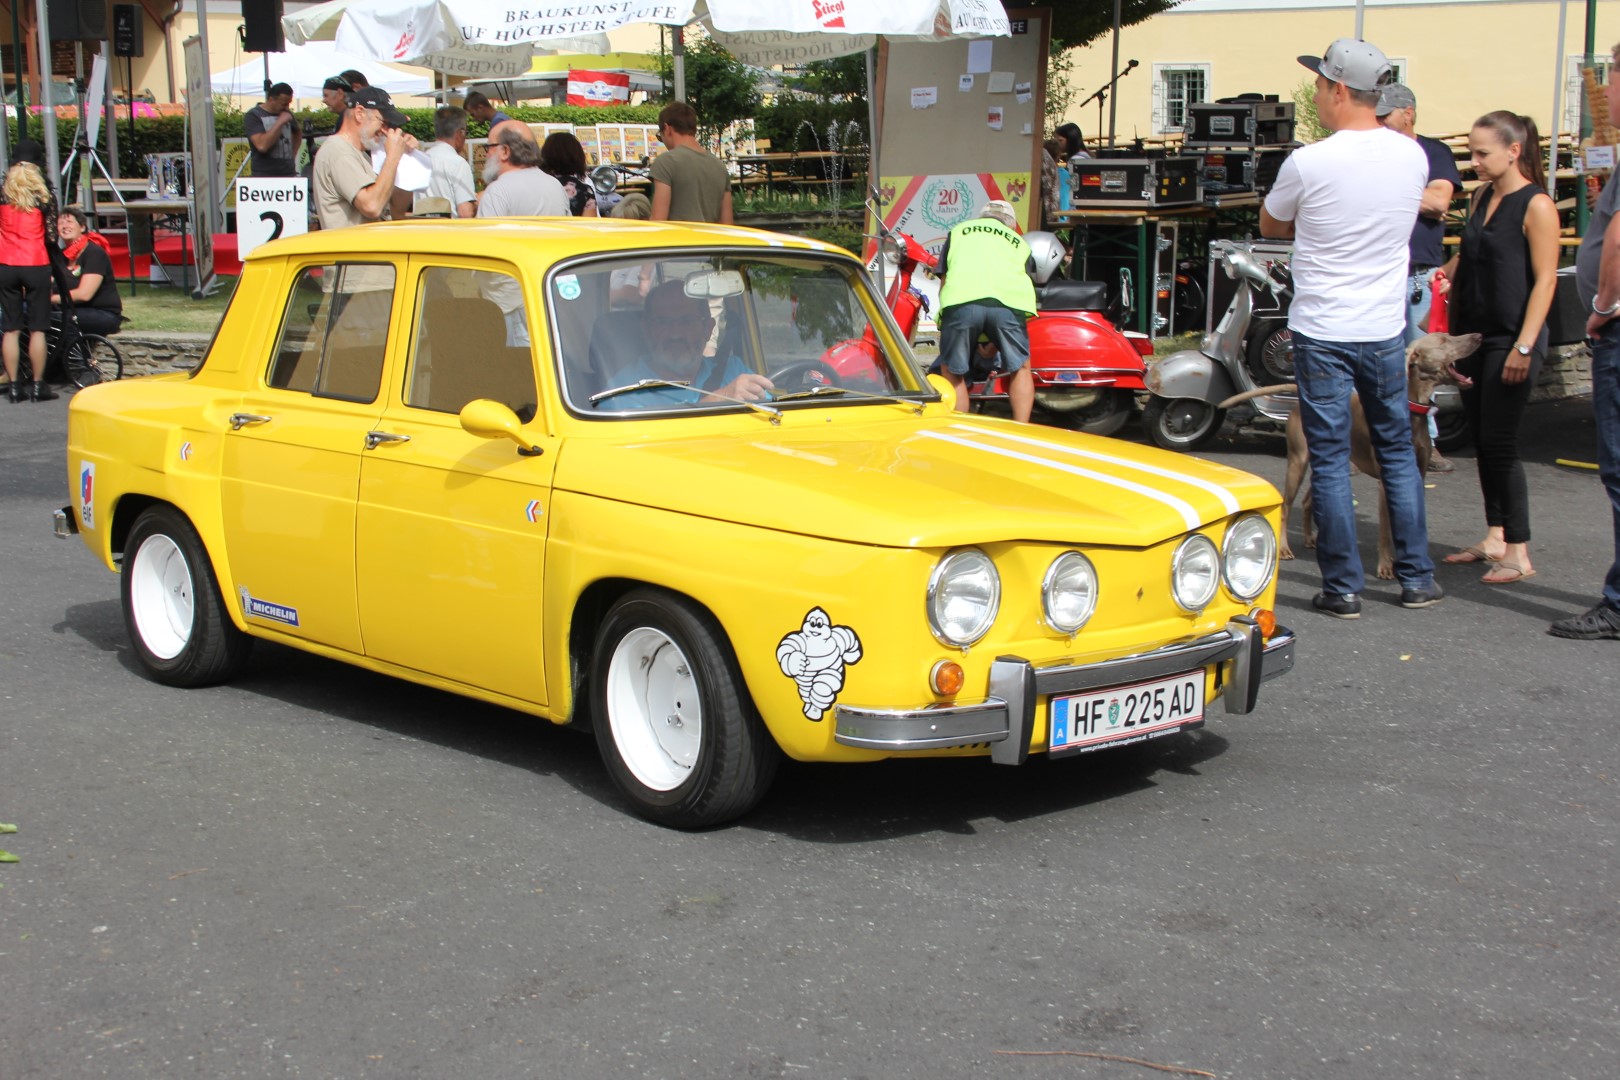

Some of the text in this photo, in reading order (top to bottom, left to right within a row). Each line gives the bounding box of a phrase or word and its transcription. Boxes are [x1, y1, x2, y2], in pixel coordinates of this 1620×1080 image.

[505, 2, 632, 23] BRAUKUNST
[812, 0, 845, 20] Stiegl
[462, 6, 677, 42] UF HÖCHSTER STUFE
[239, 185, 303, 201] Bewerb
[938, 189, 959, 206] 20
[936, 206, 960, 214] Jahre
[259, 211, 283, 243] 2
[961, 225, 1020, 248] ORDNER
[82, 506, 92, 523] elf
[253, 602, 296, 622] MICHELIN
[1074, 681, 1195, 736] HF 225 AD
[1055, 728, 1064, 740] A
